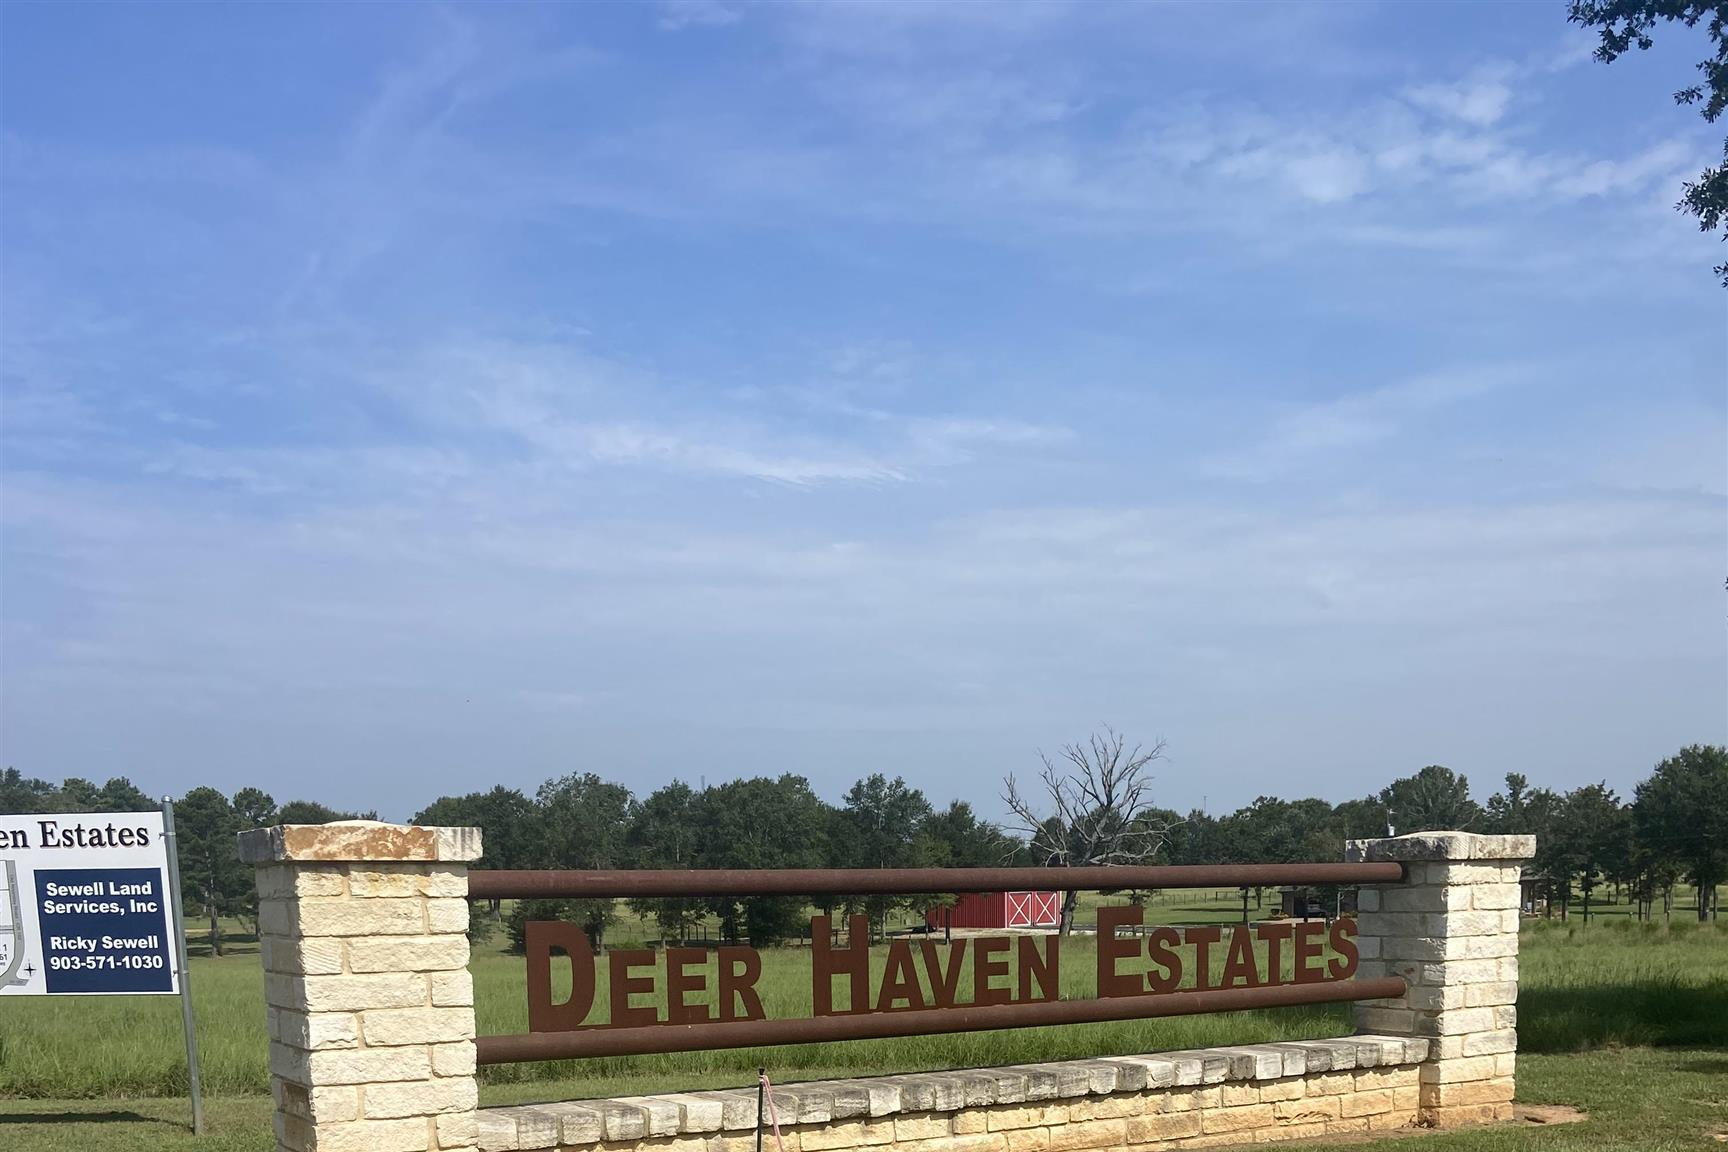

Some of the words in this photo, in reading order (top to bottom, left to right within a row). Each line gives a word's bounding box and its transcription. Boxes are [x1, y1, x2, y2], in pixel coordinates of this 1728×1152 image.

[37, 820, 150, 849] Estates
[46, 882, 104, 896] Sewell
[109, 881, 152, 896] Land
[44, 900, 125, 916] Services,
[130, 899, 158, 913] Inc
[50, 936, 97, 952] Ricky
[102, 935, 159, 949] Sewell
[51, 956, 163, 970] 903-571-1030
